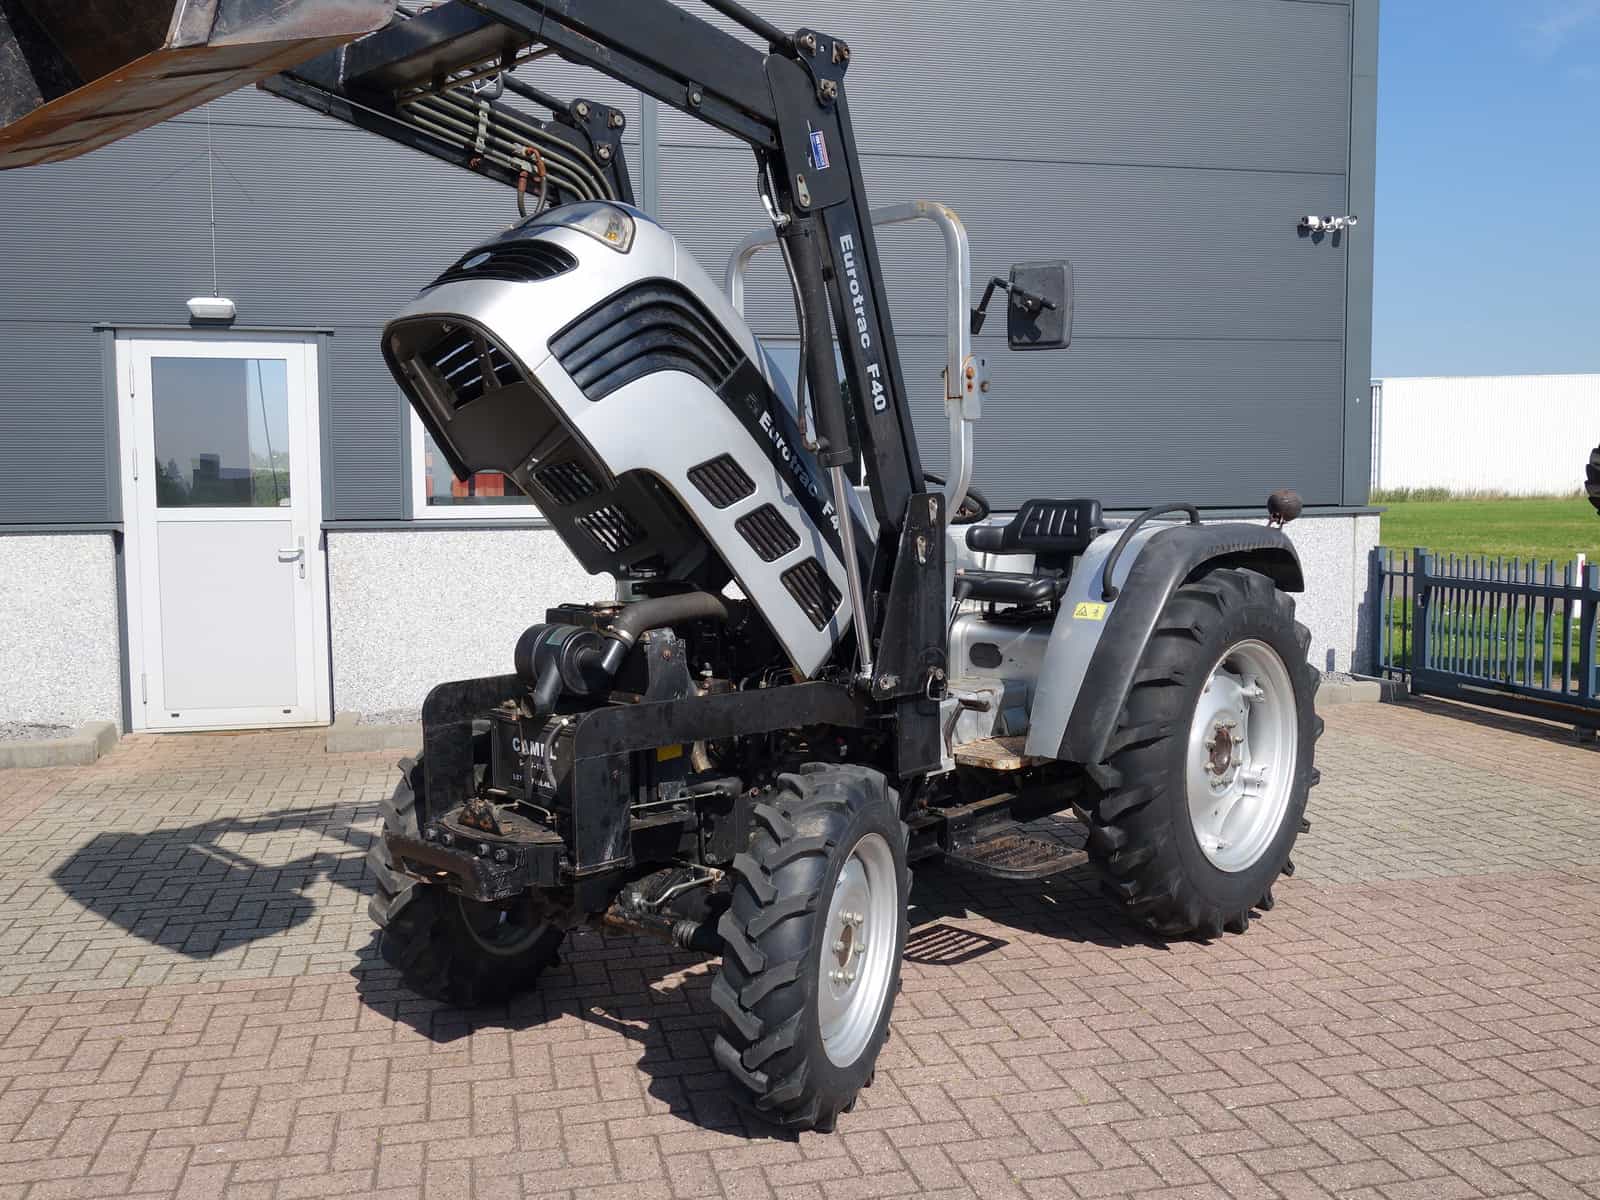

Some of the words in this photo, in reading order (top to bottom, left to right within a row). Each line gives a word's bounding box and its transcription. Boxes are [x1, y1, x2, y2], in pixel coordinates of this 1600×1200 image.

[839, 233, 870, 349] Eurotrac
[866, 363, 887, 411] F40
[759, 410, 818, 497] Eurotrac
[822, 501, 841, 536] F4
